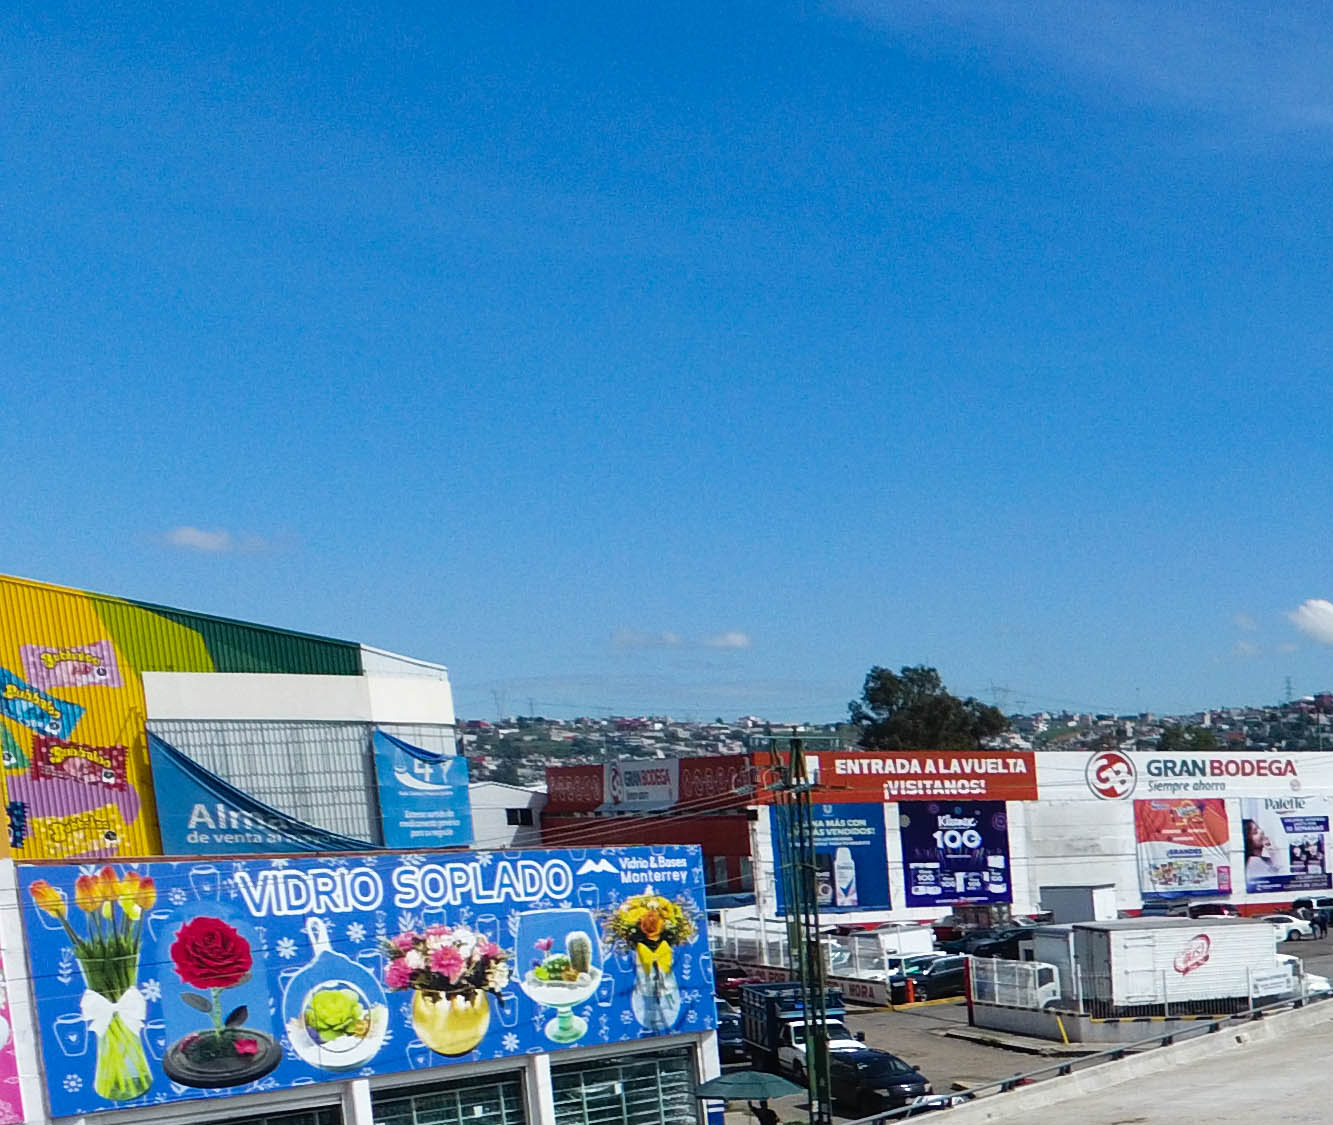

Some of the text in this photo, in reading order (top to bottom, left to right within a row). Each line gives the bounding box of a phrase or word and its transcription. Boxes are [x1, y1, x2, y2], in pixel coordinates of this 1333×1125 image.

[835, 758, 1027, 775] ENTRADA A LA VUELTA
[1146, 759, 1297, 777] GRAN BODEGA
[883, 779, 986, 799] ¡VISITANOS!
[1147, 780, 1226, 793] Siempre ahorra
[186, 831, 210, 843] de
[213, 832, 262, 843] venta
[619, 857, 648, 868] Vidrio
[659, 857, 688, 868] Bases
[620, 870, 688, 884] Monterrey
[237, 859, 573, 916] VIDRIO SOPLADO
